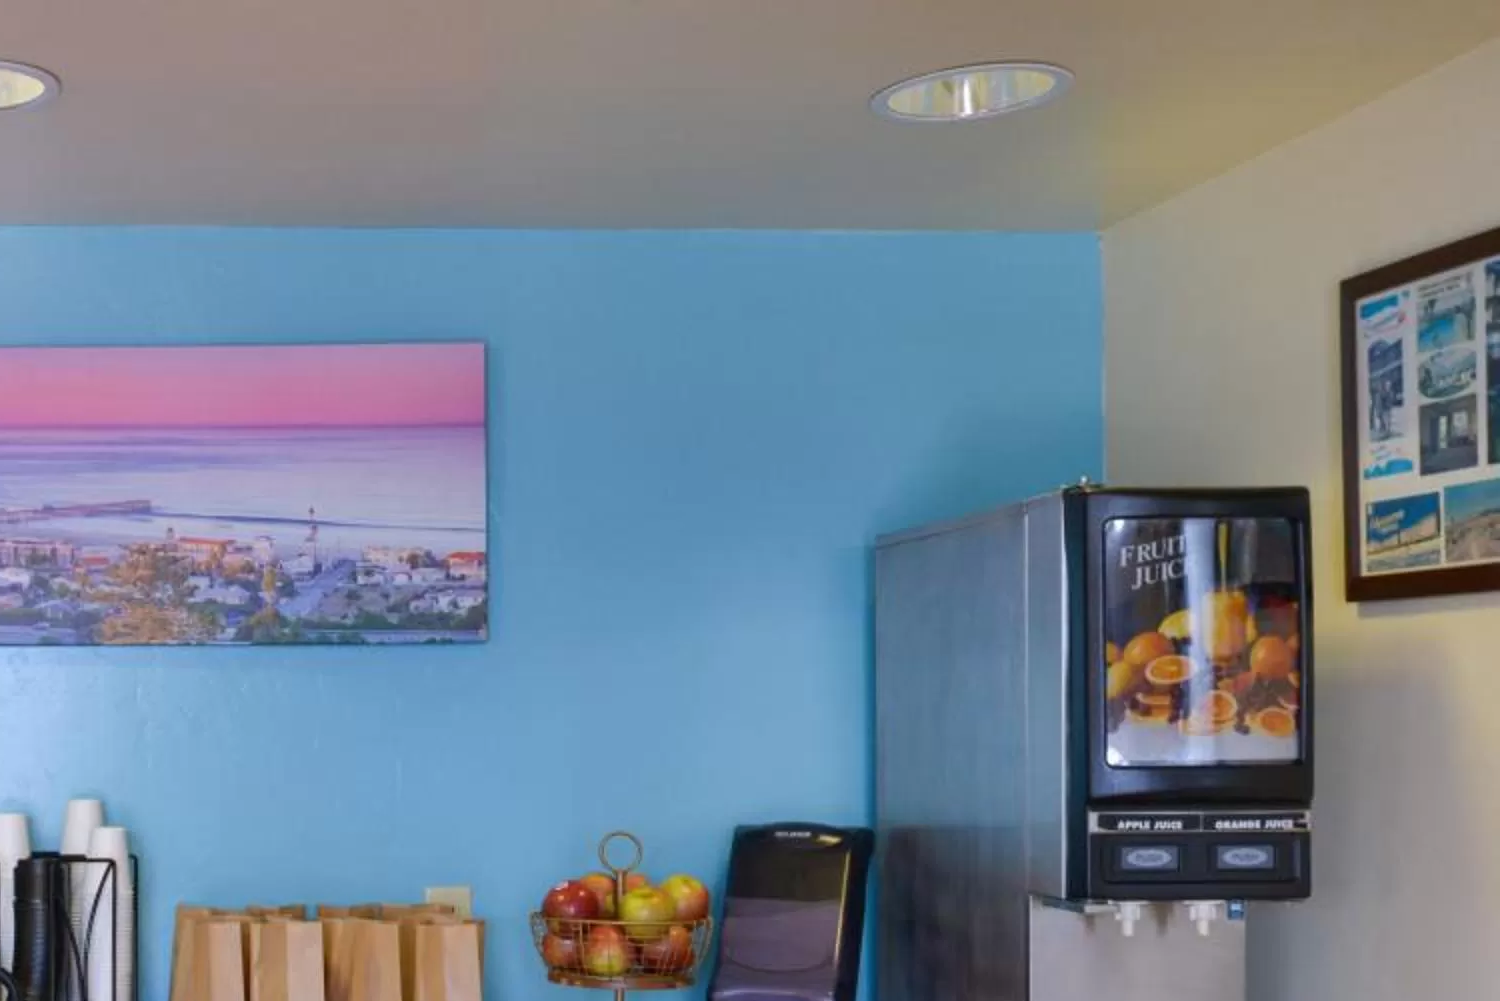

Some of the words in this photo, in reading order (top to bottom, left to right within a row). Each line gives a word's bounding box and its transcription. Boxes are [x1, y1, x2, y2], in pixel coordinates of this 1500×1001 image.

[1120, 535, 1186, 568] FRUIT
[1131, 555, 1188, 590] JUIC
[1117, 819, 1150, 830] APPLE
[1154, 819, 1184, 830] JUICE
[1215, 818, 1261, 830] ORANGE
[1265, 818, 1294, 829] JUICE
